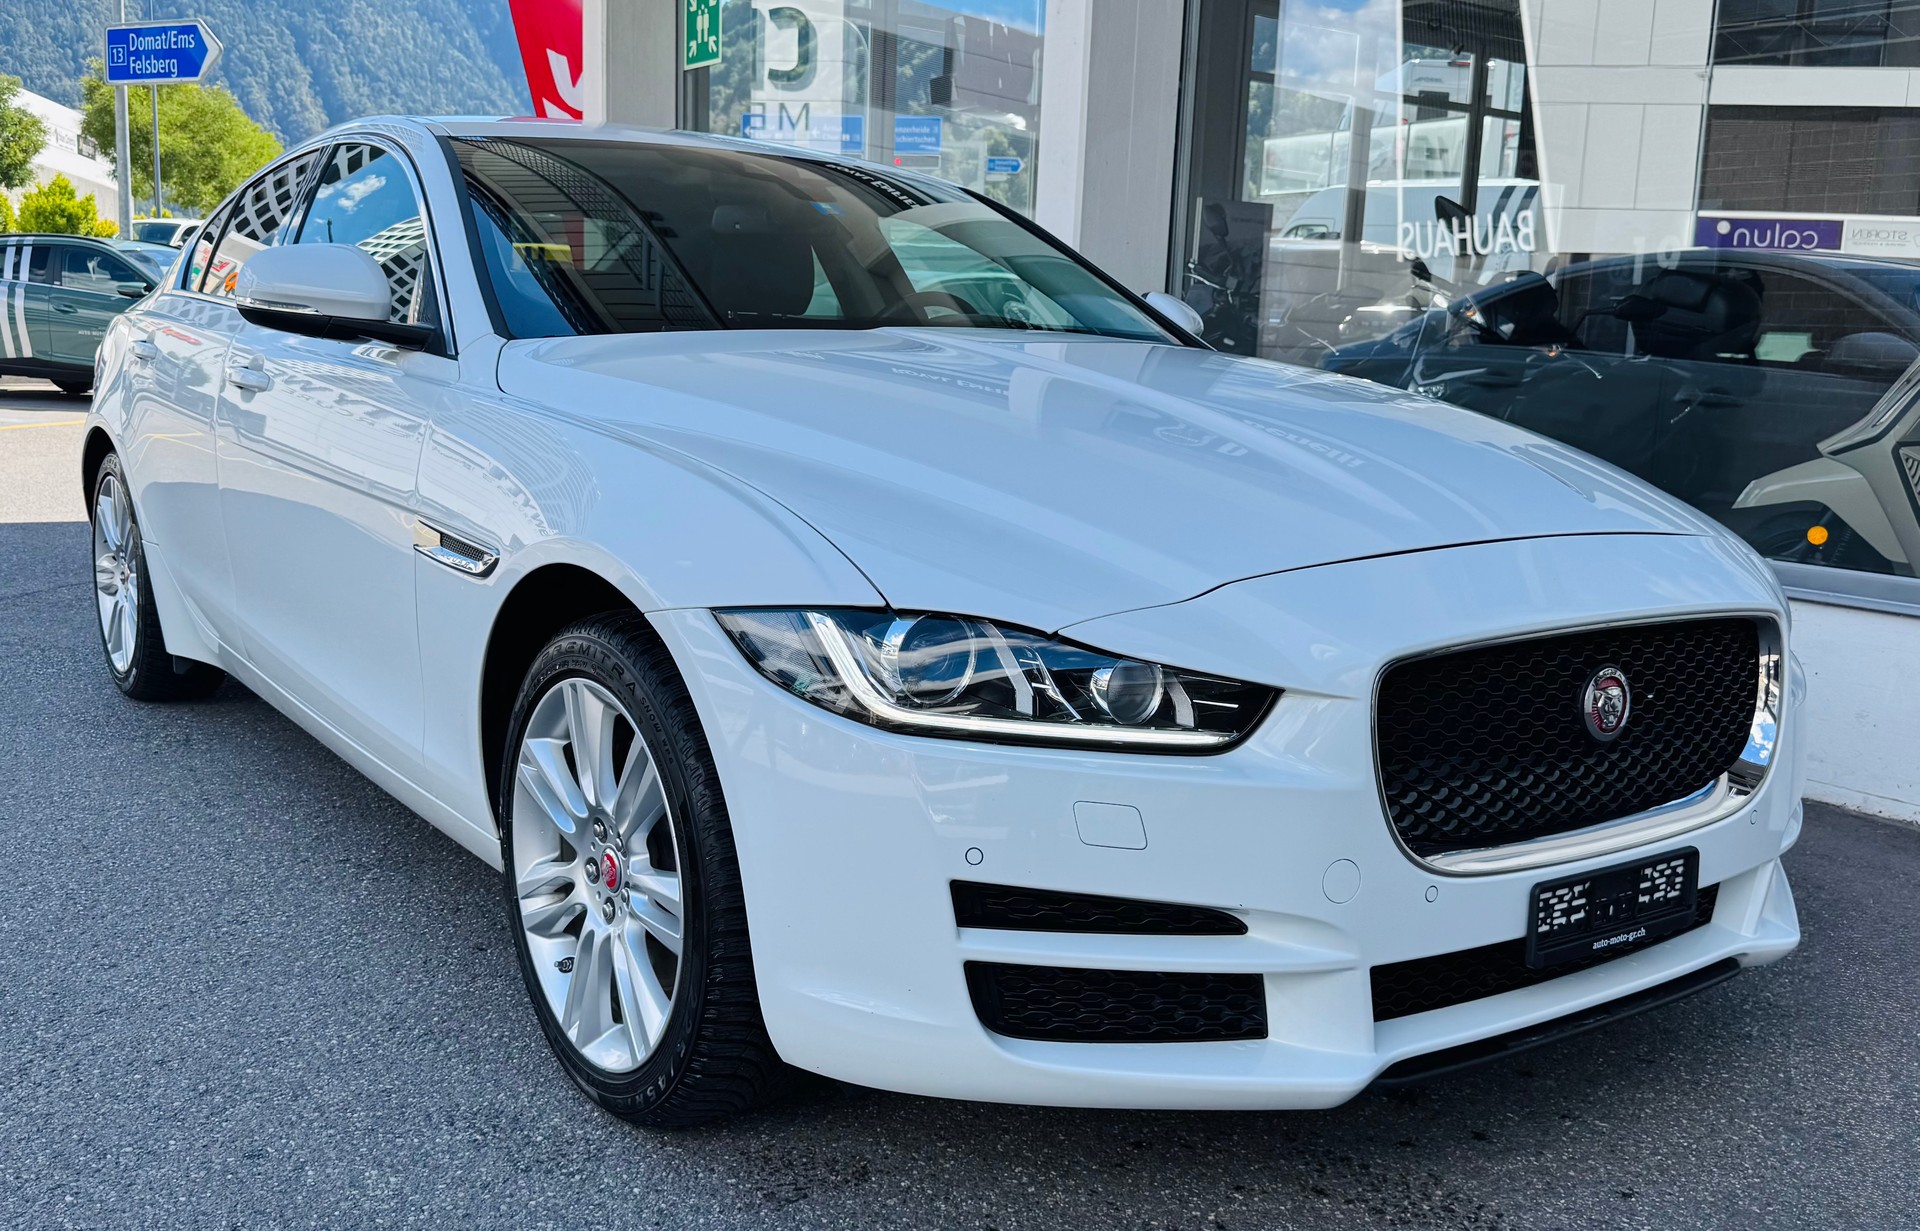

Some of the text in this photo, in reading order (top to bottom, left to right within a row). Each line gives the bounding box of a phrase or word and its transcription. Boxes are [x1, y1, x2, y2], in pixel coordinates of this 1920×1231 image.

[129, 30, 195, 51] Domat/Ems
[112, 47, 124, 63] 13
[129, 54, 178, 78] Felsberg
[1592, 926, 1646, 950] auto-moto-gr.ch
